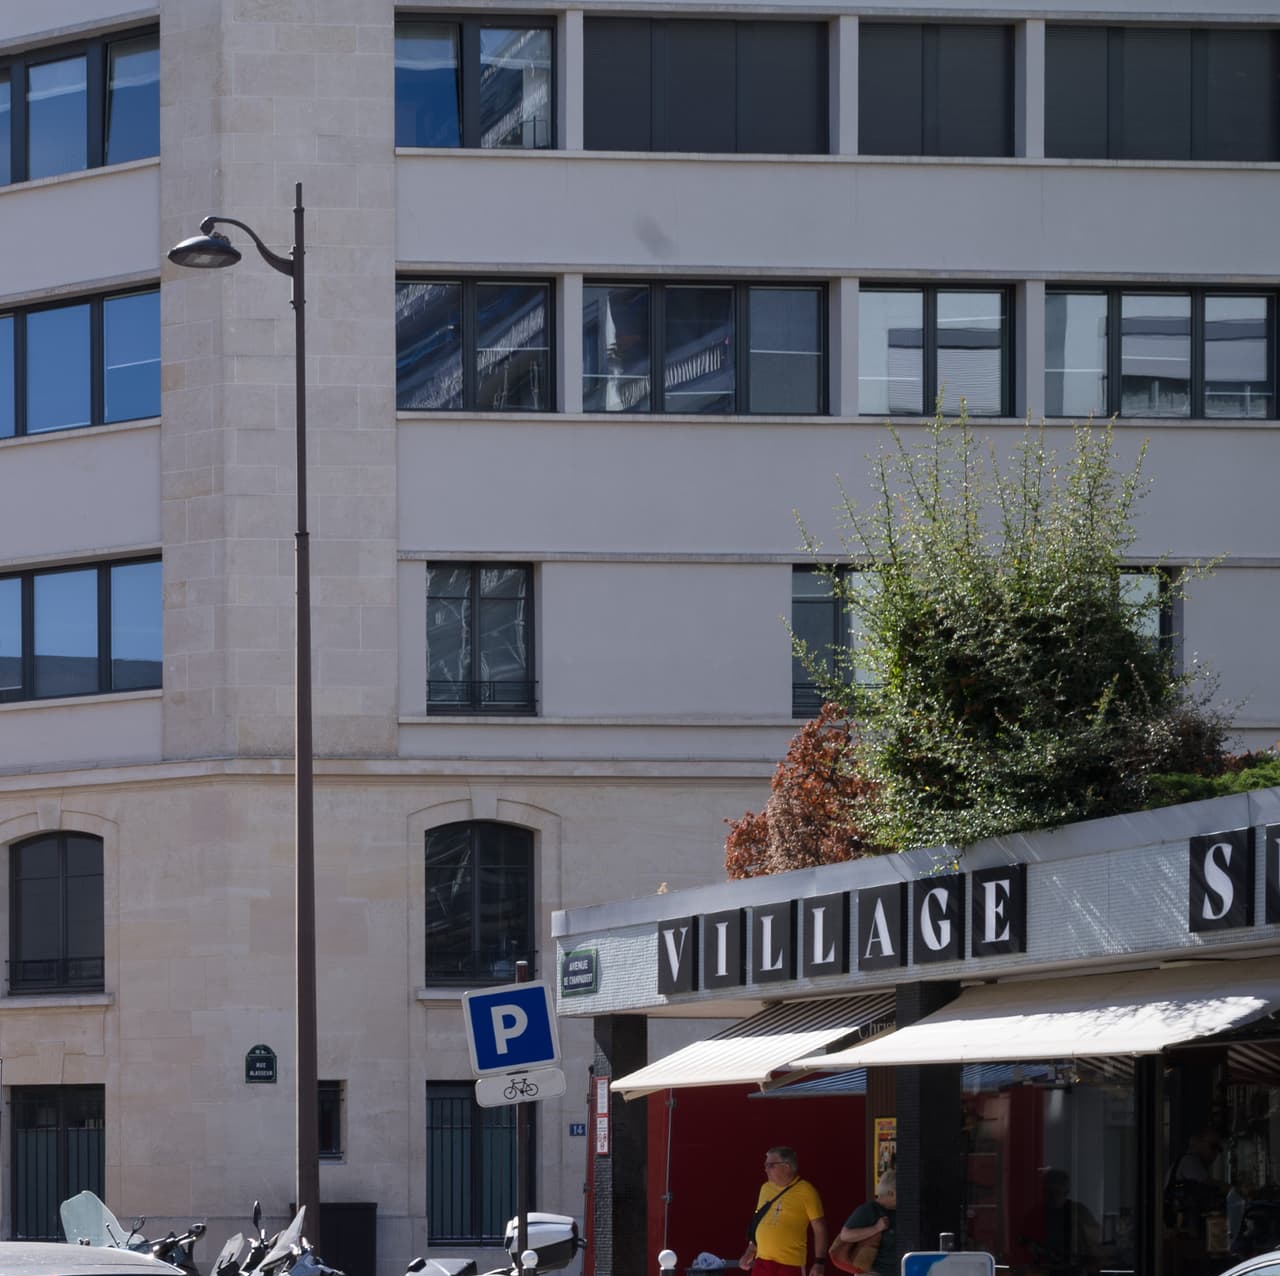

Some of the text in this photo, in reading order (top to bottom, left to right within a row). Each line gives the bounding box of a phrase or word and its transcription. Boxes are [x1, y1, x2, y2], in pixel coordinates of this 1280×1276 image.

[663, 839, 1280, 984] VILLAGE S
[490, 1004, 528, 1055] P
[573, 1125, 584, 1135] 14
